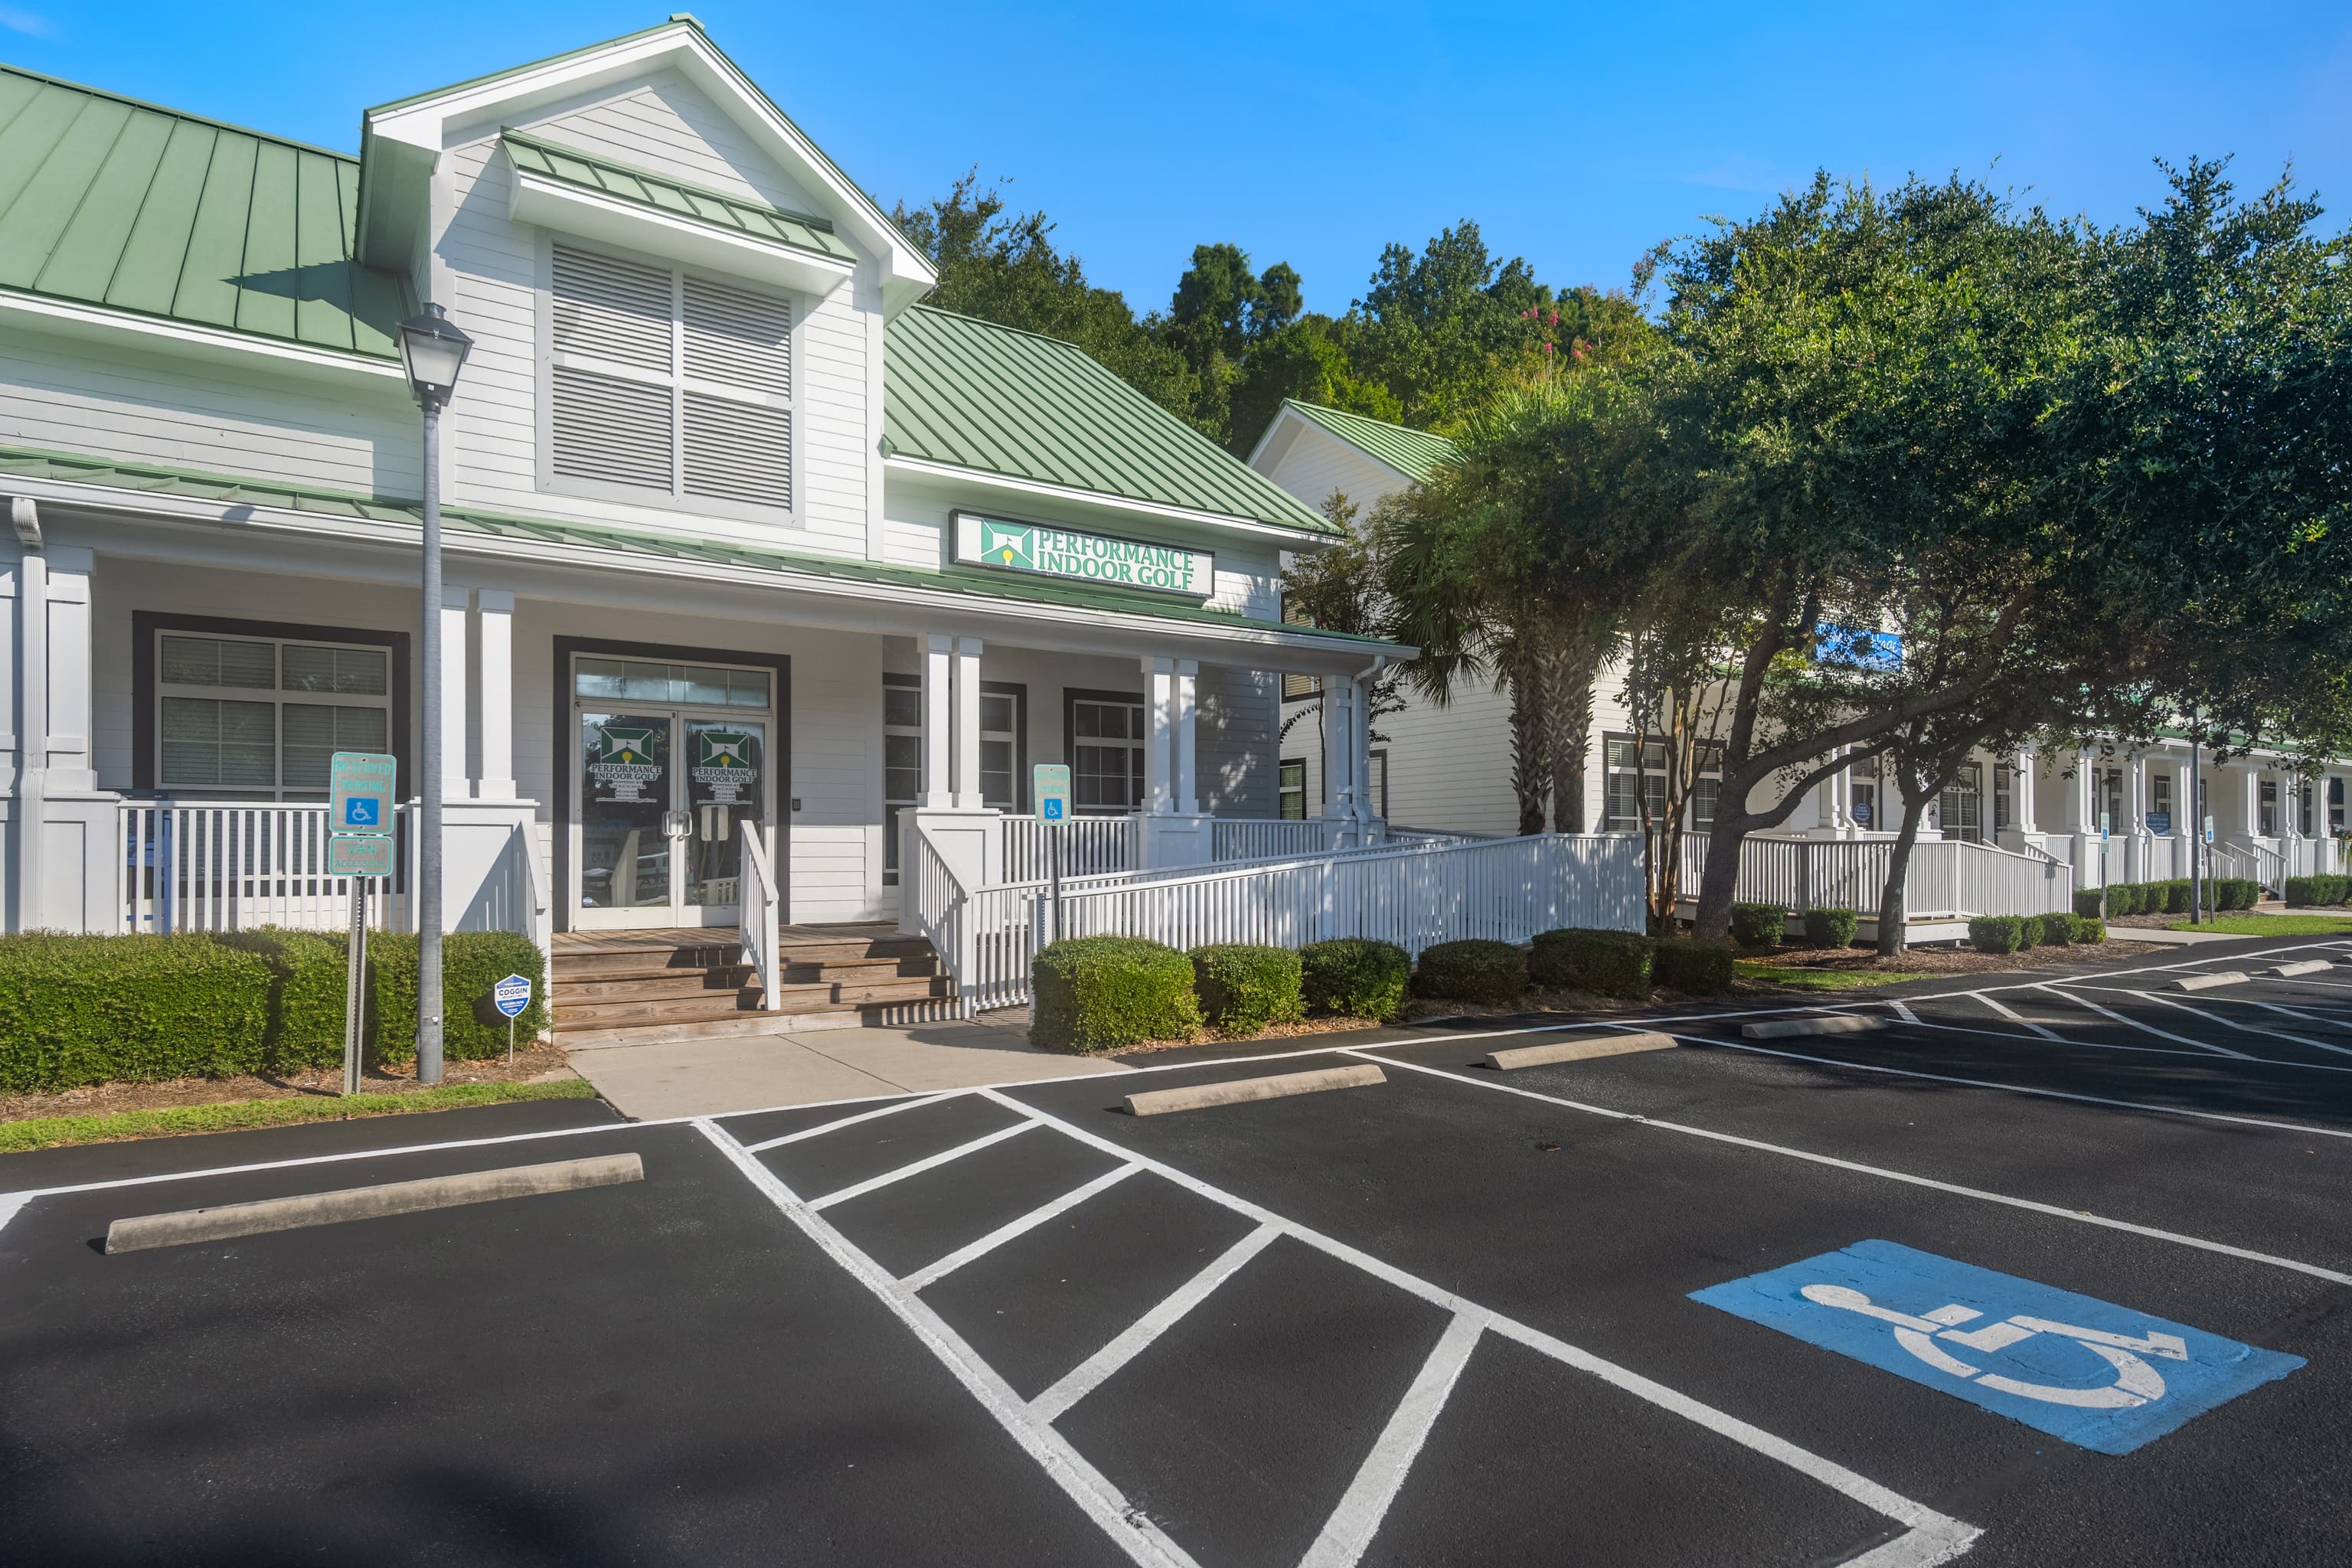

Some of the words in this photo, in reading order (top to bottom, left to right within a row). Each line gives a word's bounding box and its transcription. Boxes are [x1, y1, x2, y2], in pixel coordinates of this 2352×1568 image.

[1038, 528, 1194, 572] PERFORMANCE
[1038, 550, 1133, 583] INDOOR
[1137, 566, 1193, 591] GOLF
[335, 760, 392, 776] RESERVED
[592, 764, 662, 774] PERFORMANCE
[693, 768, 757, 777] PERFORMANCE
[340, 778, 387, 793] PARKING
[347, 844, 377, 855] VAN
[335, 859, 387, 869] ACCESSIBLE
[498, 987, 528, 996] COGGIN
